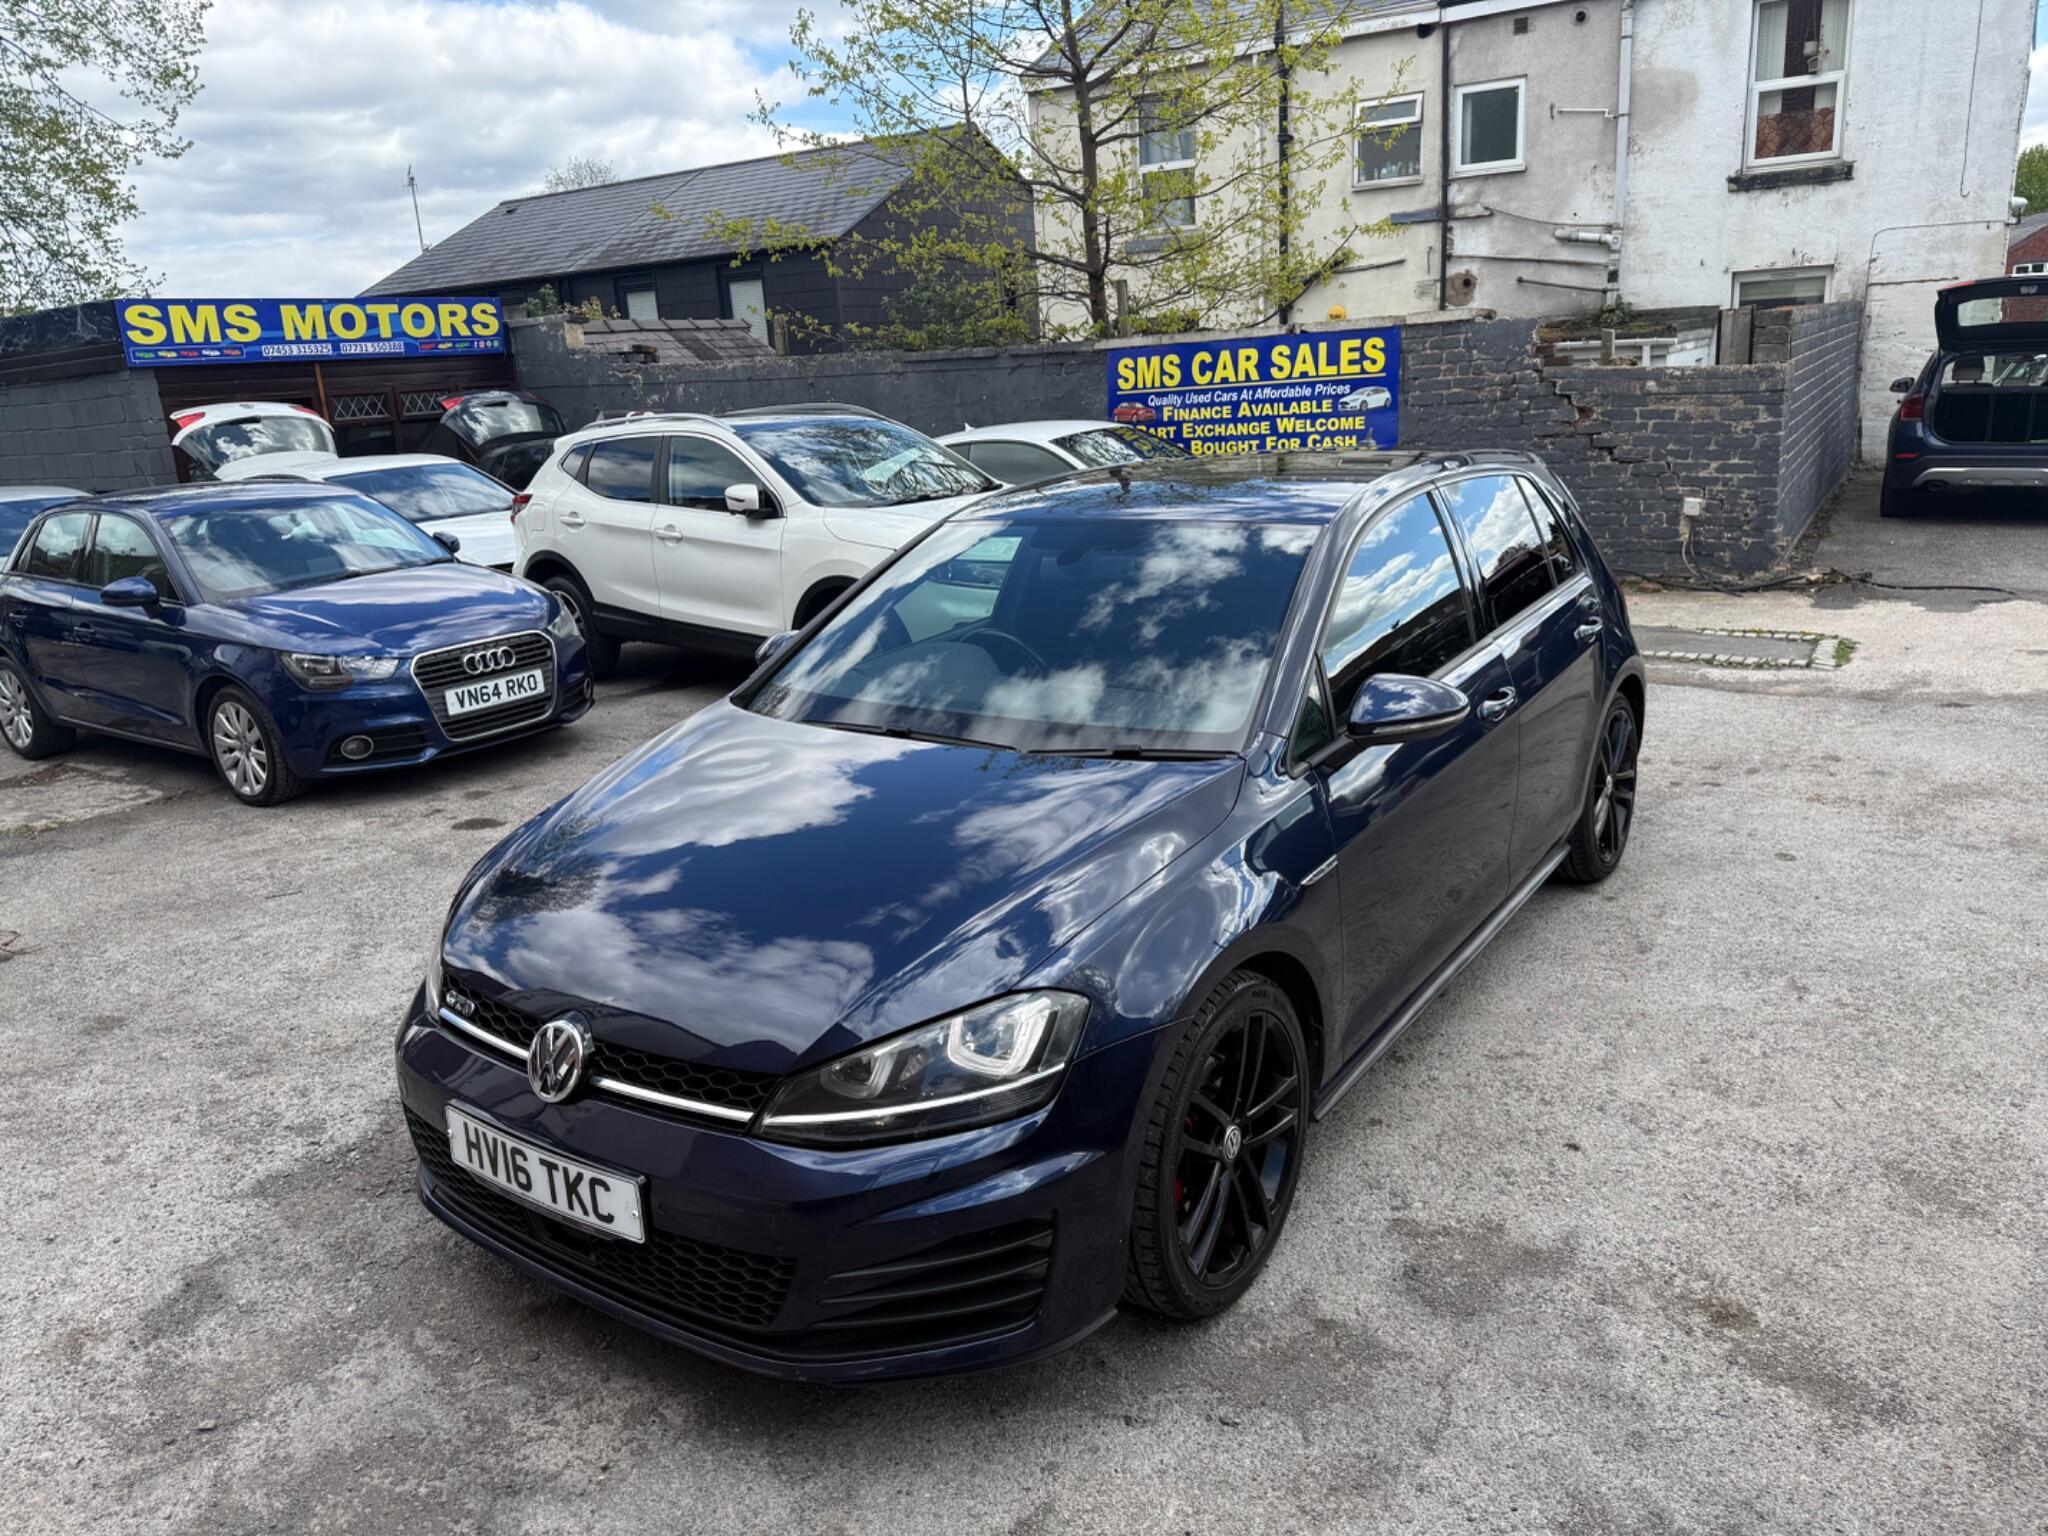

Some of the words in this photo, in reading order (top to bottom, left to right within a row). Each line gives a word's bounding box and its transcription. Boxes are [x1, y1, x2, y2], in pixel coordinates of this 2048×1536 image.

[124, 304, 262, 345] SMS
[280, 302, 500, 341] MOTORS
[1117, 354, 1181, 391] SMS
[1191, 348, 1260, 385] CAR
[1270, 337, 1386, 380] SALES
[1148, 394, 1182, 407] Quality
[1185, 392, 1211, 404] Used
[1214, 390, 1238, 402] Cars
[1240, 388, 1253, 400] At
[1254, 384, 1312, 400] Affordable
[1315, 382, 1351, 396] Prices
[1162, 405, 1232, 421] FINANCE
[1237, 400, 1333, 418] AVAILABLE
[1182, 421, 1271, 439] EXCHANGE
[1276, 416, 1366, 434] WELCOME
[1191, 439, 1260, 456] BOUGHT
[1266, 436, 1301, 451] FOR
[1307, 434, 1357, 449] CASH
[455, 682, 502, 709] VN64
[505, 673, 538, 697] RKO
[462, 1122, 533, 1193] HV16
[539, 1157, 615, 1225] TKC
